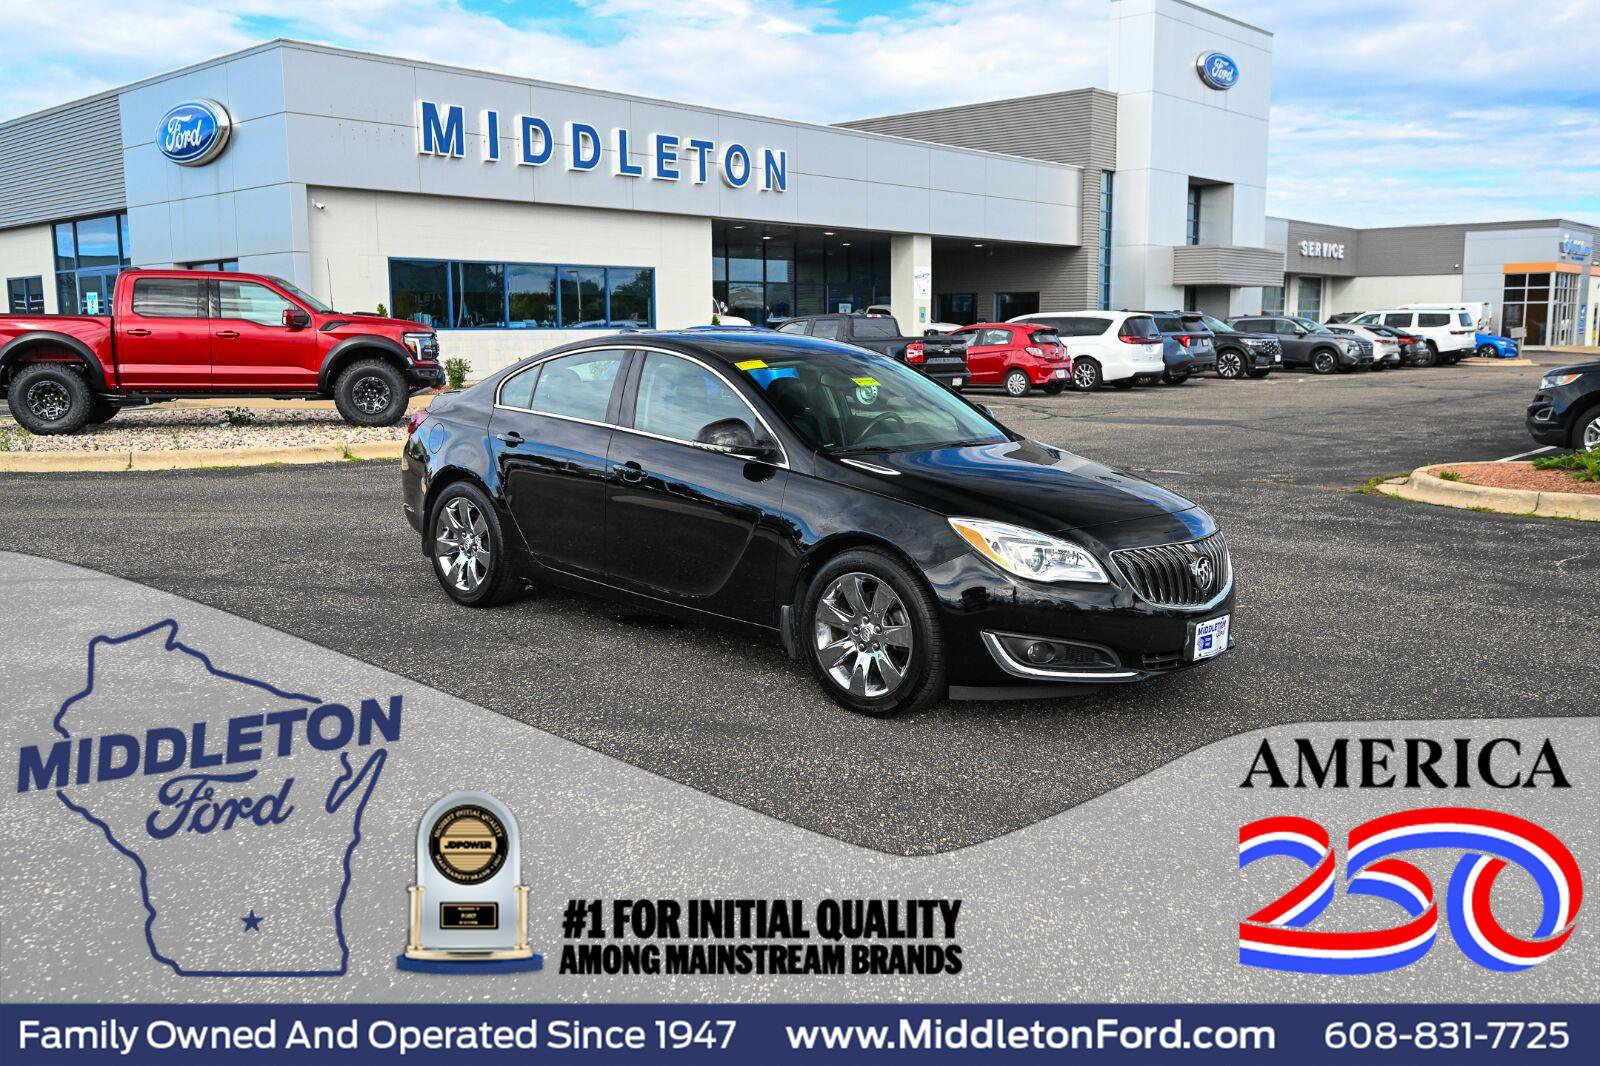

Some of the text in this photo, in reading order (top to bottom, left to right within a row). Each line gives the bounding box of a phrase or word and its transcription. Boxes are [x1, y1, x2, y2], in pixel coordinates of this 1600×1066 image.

[1211, 57, 1235, 82] Ford
[165, 114, 203, 152] Ford
[418, 99, 788, 192] MIDDLETON
[1299, 240, 1345, 260] SERVICE
[1197, 620, 1227, 635] MIDDLETON
